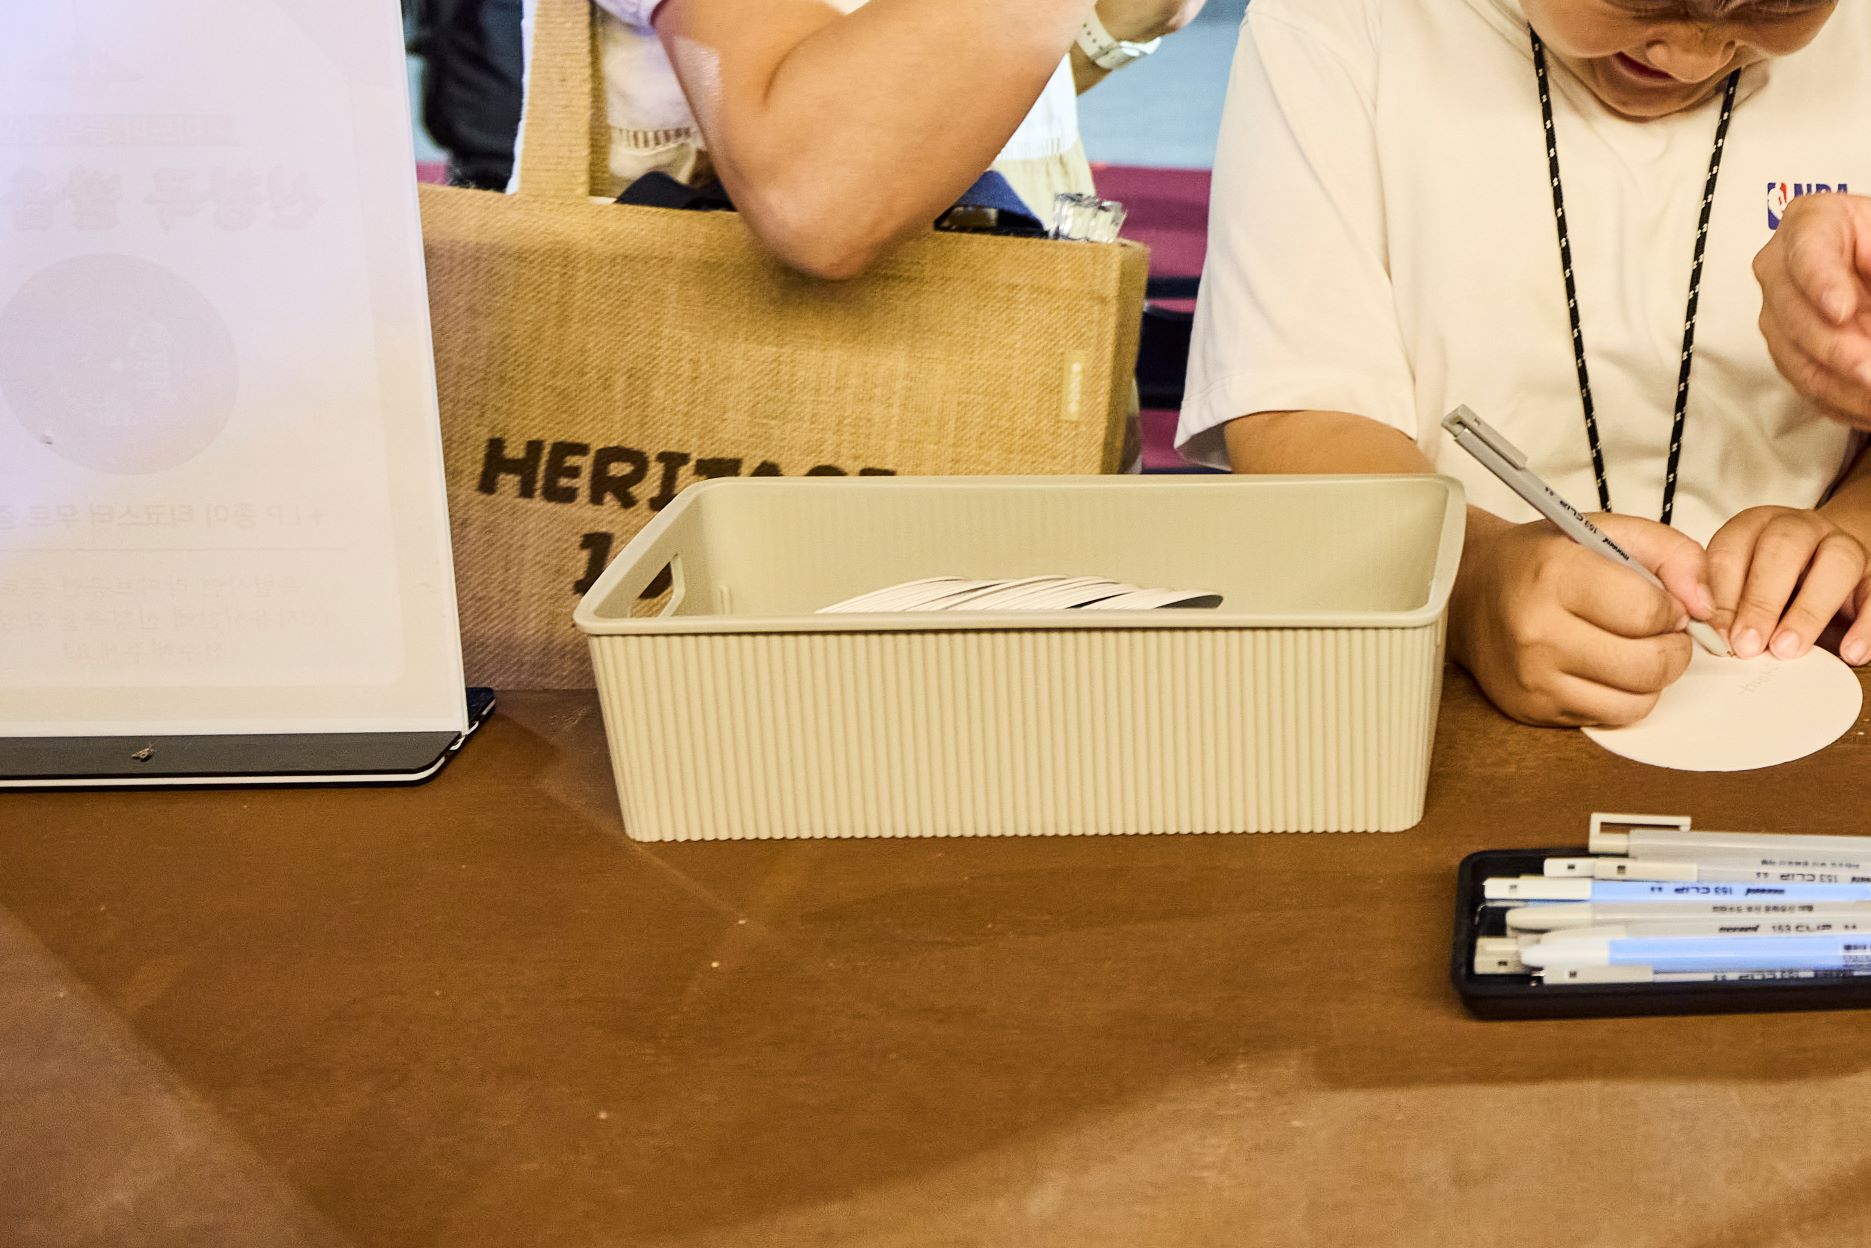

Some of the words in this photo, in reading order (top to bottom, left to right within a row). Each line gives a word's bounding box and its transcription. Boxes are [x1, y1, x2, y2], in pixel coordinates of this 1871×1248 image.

[476, 437, 897, 512] HERI
[1559, 500, 1583, 521] CLIP
[1584, 520, 1597, 534] 153
[1780, 872, 1815, 882] CLIP
[1820, 873, 1838, 883] 153
[1674, 887, 1710, 895] CLIP
[1795, 924, 1832, 932] CLIP
